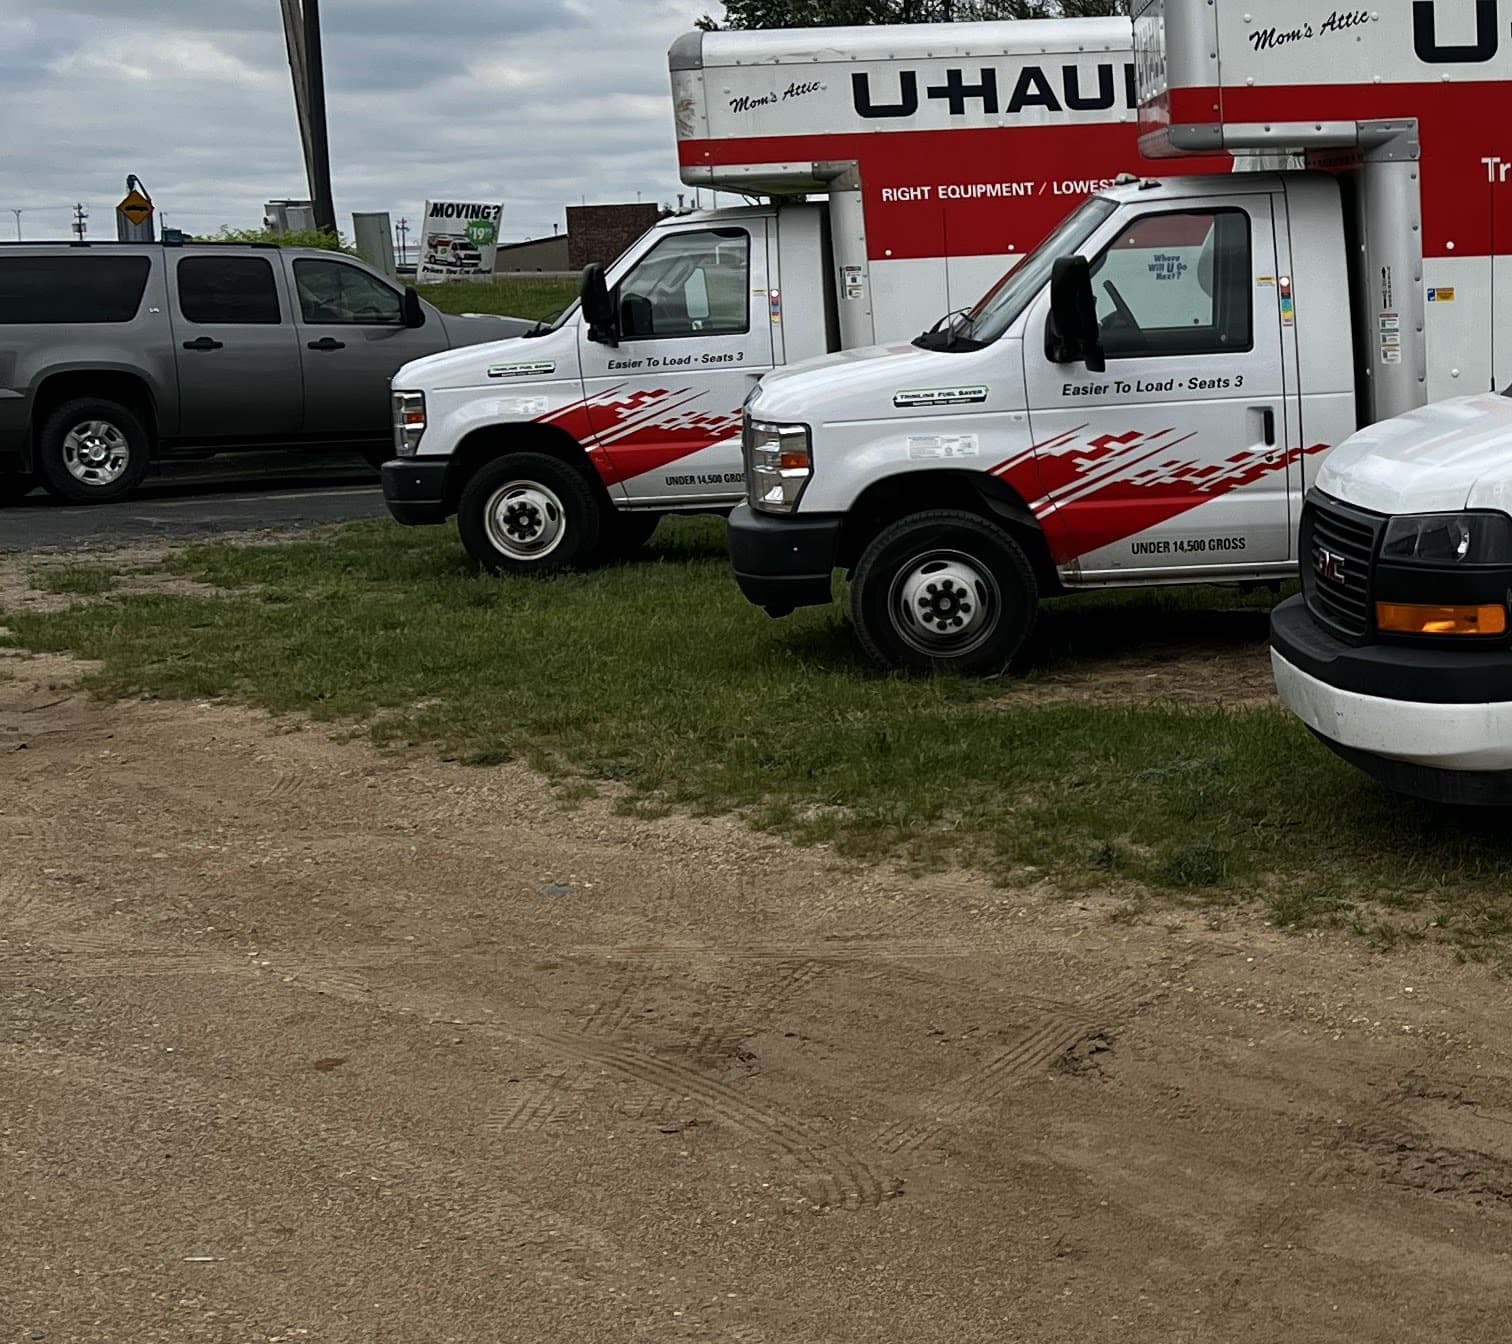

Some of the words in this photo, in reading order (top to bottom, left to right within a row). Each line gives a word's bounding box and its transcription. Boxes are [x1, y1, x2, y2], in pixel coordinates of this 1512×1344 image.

[1249, 22, 1314, 52] Mom's
[1319, 10, 1370, 36] Attic
[729, 91, 778, 115] Mom's
[782, 80, 821, 100] Attic
[851, 63, 1137, 119] U-HAU
[882, 186, 929, 202] RIGHT
[938, 182, 1035, 199] EQUIPMENT
[429, 202, 501, 220] MOVING?
[607, 359, 642, 371] Easier
[645, 357, 661, 368] To
[663, 355, 691, 366] Load
[701, 353, 734, 364] Seats
[735, 352, 744, 362] 3
[1062, 382, 1111, 396] Easier
[1114, 381, 1133, 395] To
[1136, 379, 1174, 393] Load
[1187, 376, 1231, 390] Seats
[1234, 375, 1244, 388] 3
[665, 475, 696, 486] UNDER
[697, 473, 723, 485] 14,500
[723, 472, 747, 483] GROS
[1131, 541, 1171, 556] UNDER
[1173, 539, 1207, 555] 14,500
[1208, 537, 1247, 552] GROSS
